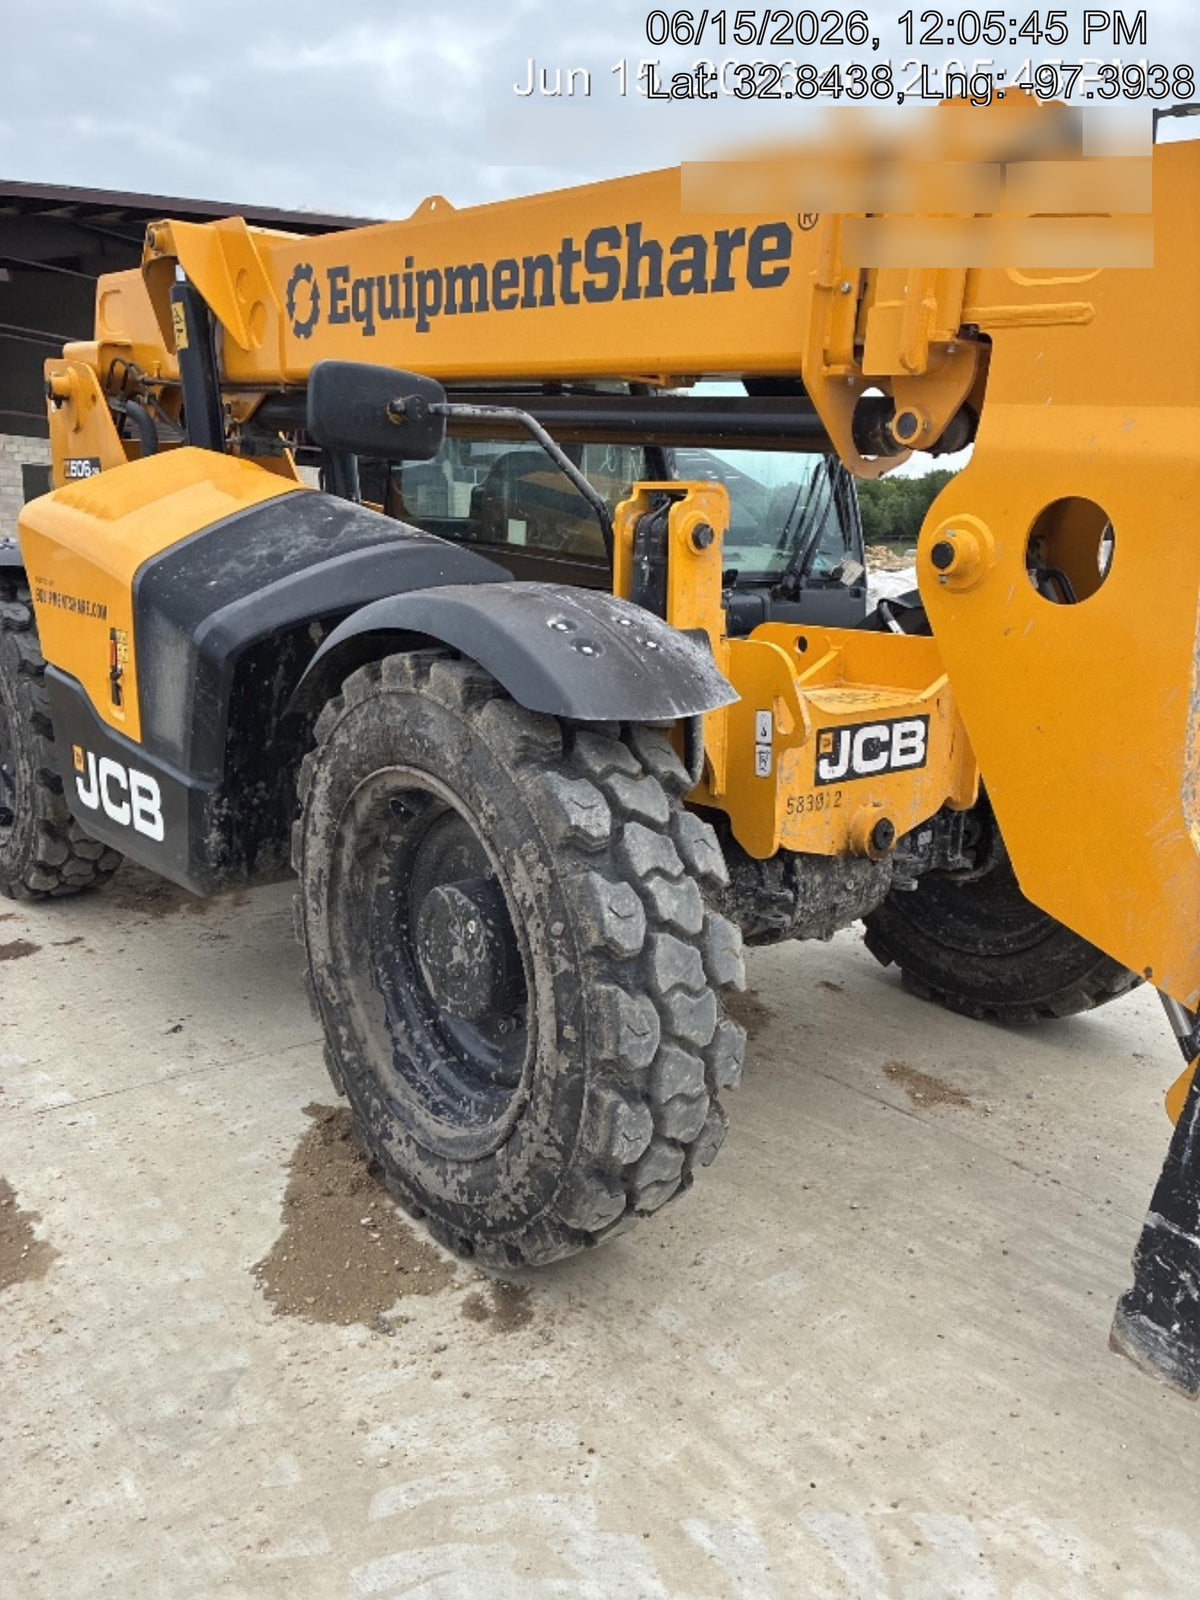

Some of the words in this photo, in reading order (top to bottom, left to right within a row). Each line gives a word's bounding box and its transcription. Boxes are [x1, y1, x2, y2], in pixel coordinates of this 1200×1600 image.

[326, 221, 793, 336] EquipmentShare
[818, 719, 927, 779] JCB
[76, 751, 164, 842] JCB
